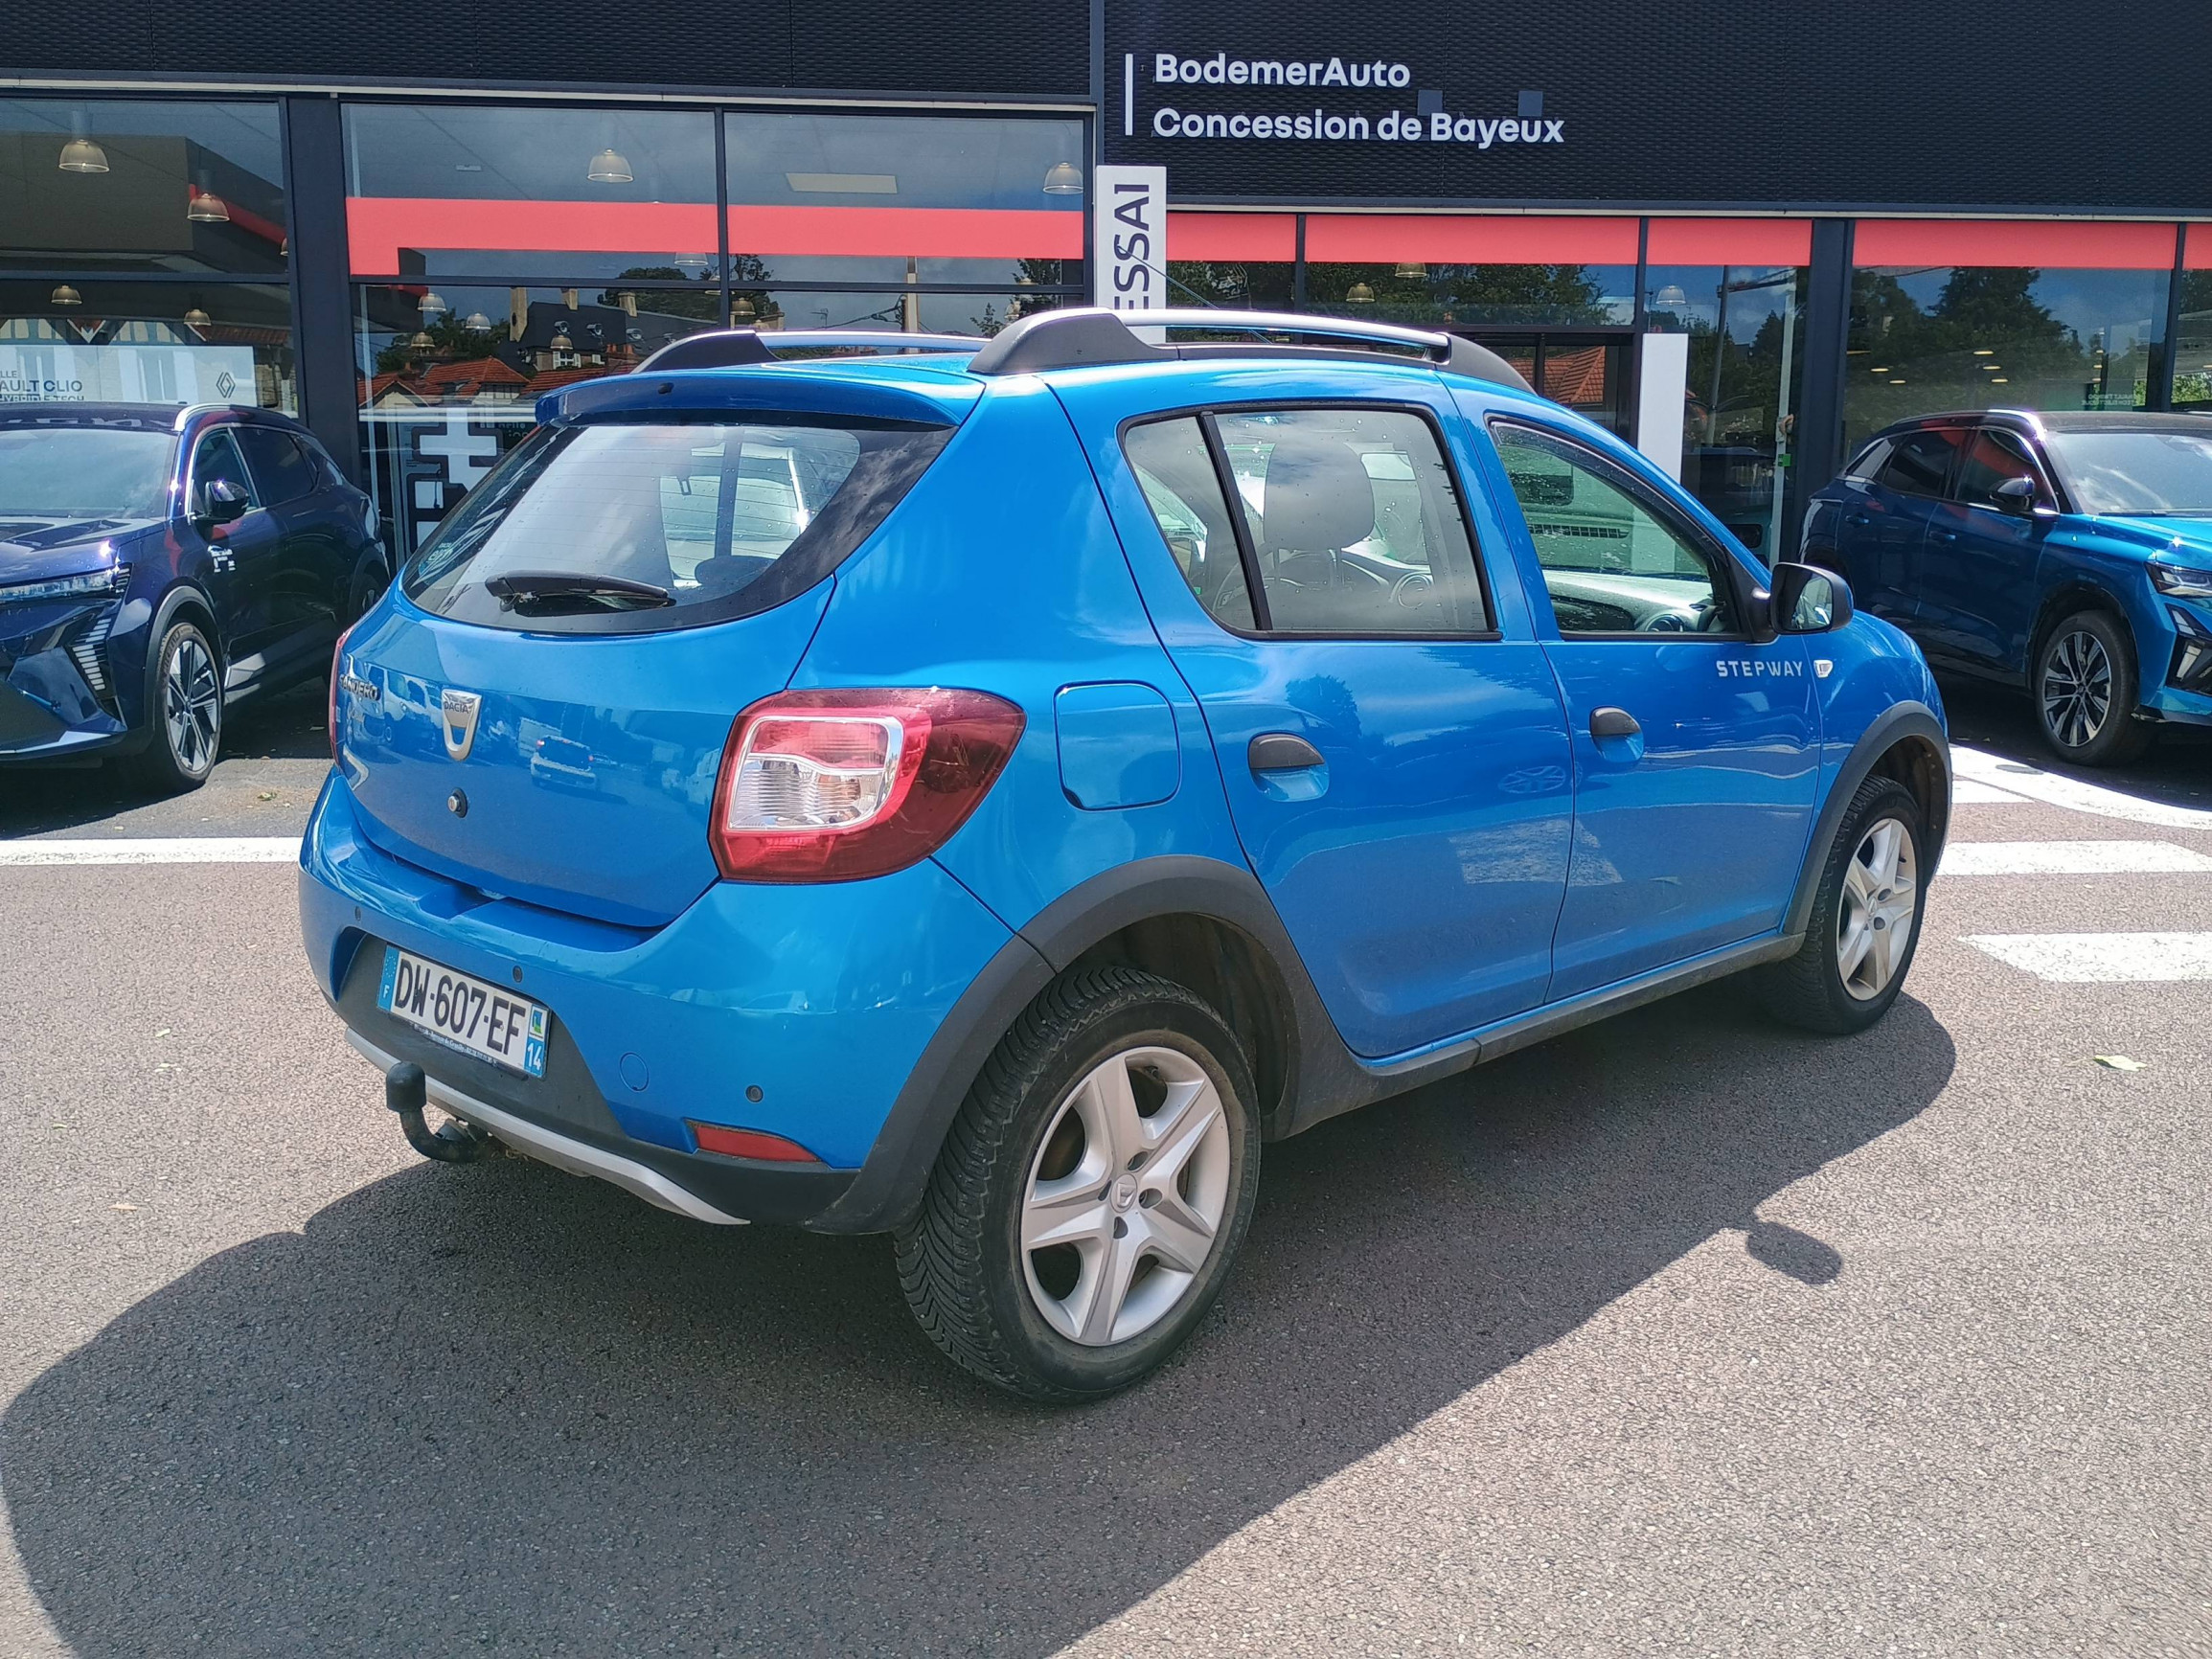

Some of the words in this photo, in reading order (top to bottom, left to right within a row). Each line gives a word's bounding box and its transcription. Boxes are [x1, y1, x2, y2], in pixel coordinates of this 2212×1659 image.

[1154, 52, 1411, 88] BodemerAuto
[1152, 107, 1369, 141] Concession
[1377, 110, 1422, 142] de
[1430, 111, 1565, 148] Bayeux
[1113, 183, 1151, 310] ESSAI
[43, 379, 83, 393] CLIO
[1716, 660, 1803, 677] STEPWAY
[339, 673, 379, 700] SANDERO
[444, 700, 469, 715] DACIA
[382, 984, 390, 998] F
[527, 1042, 542, 1072] 14
